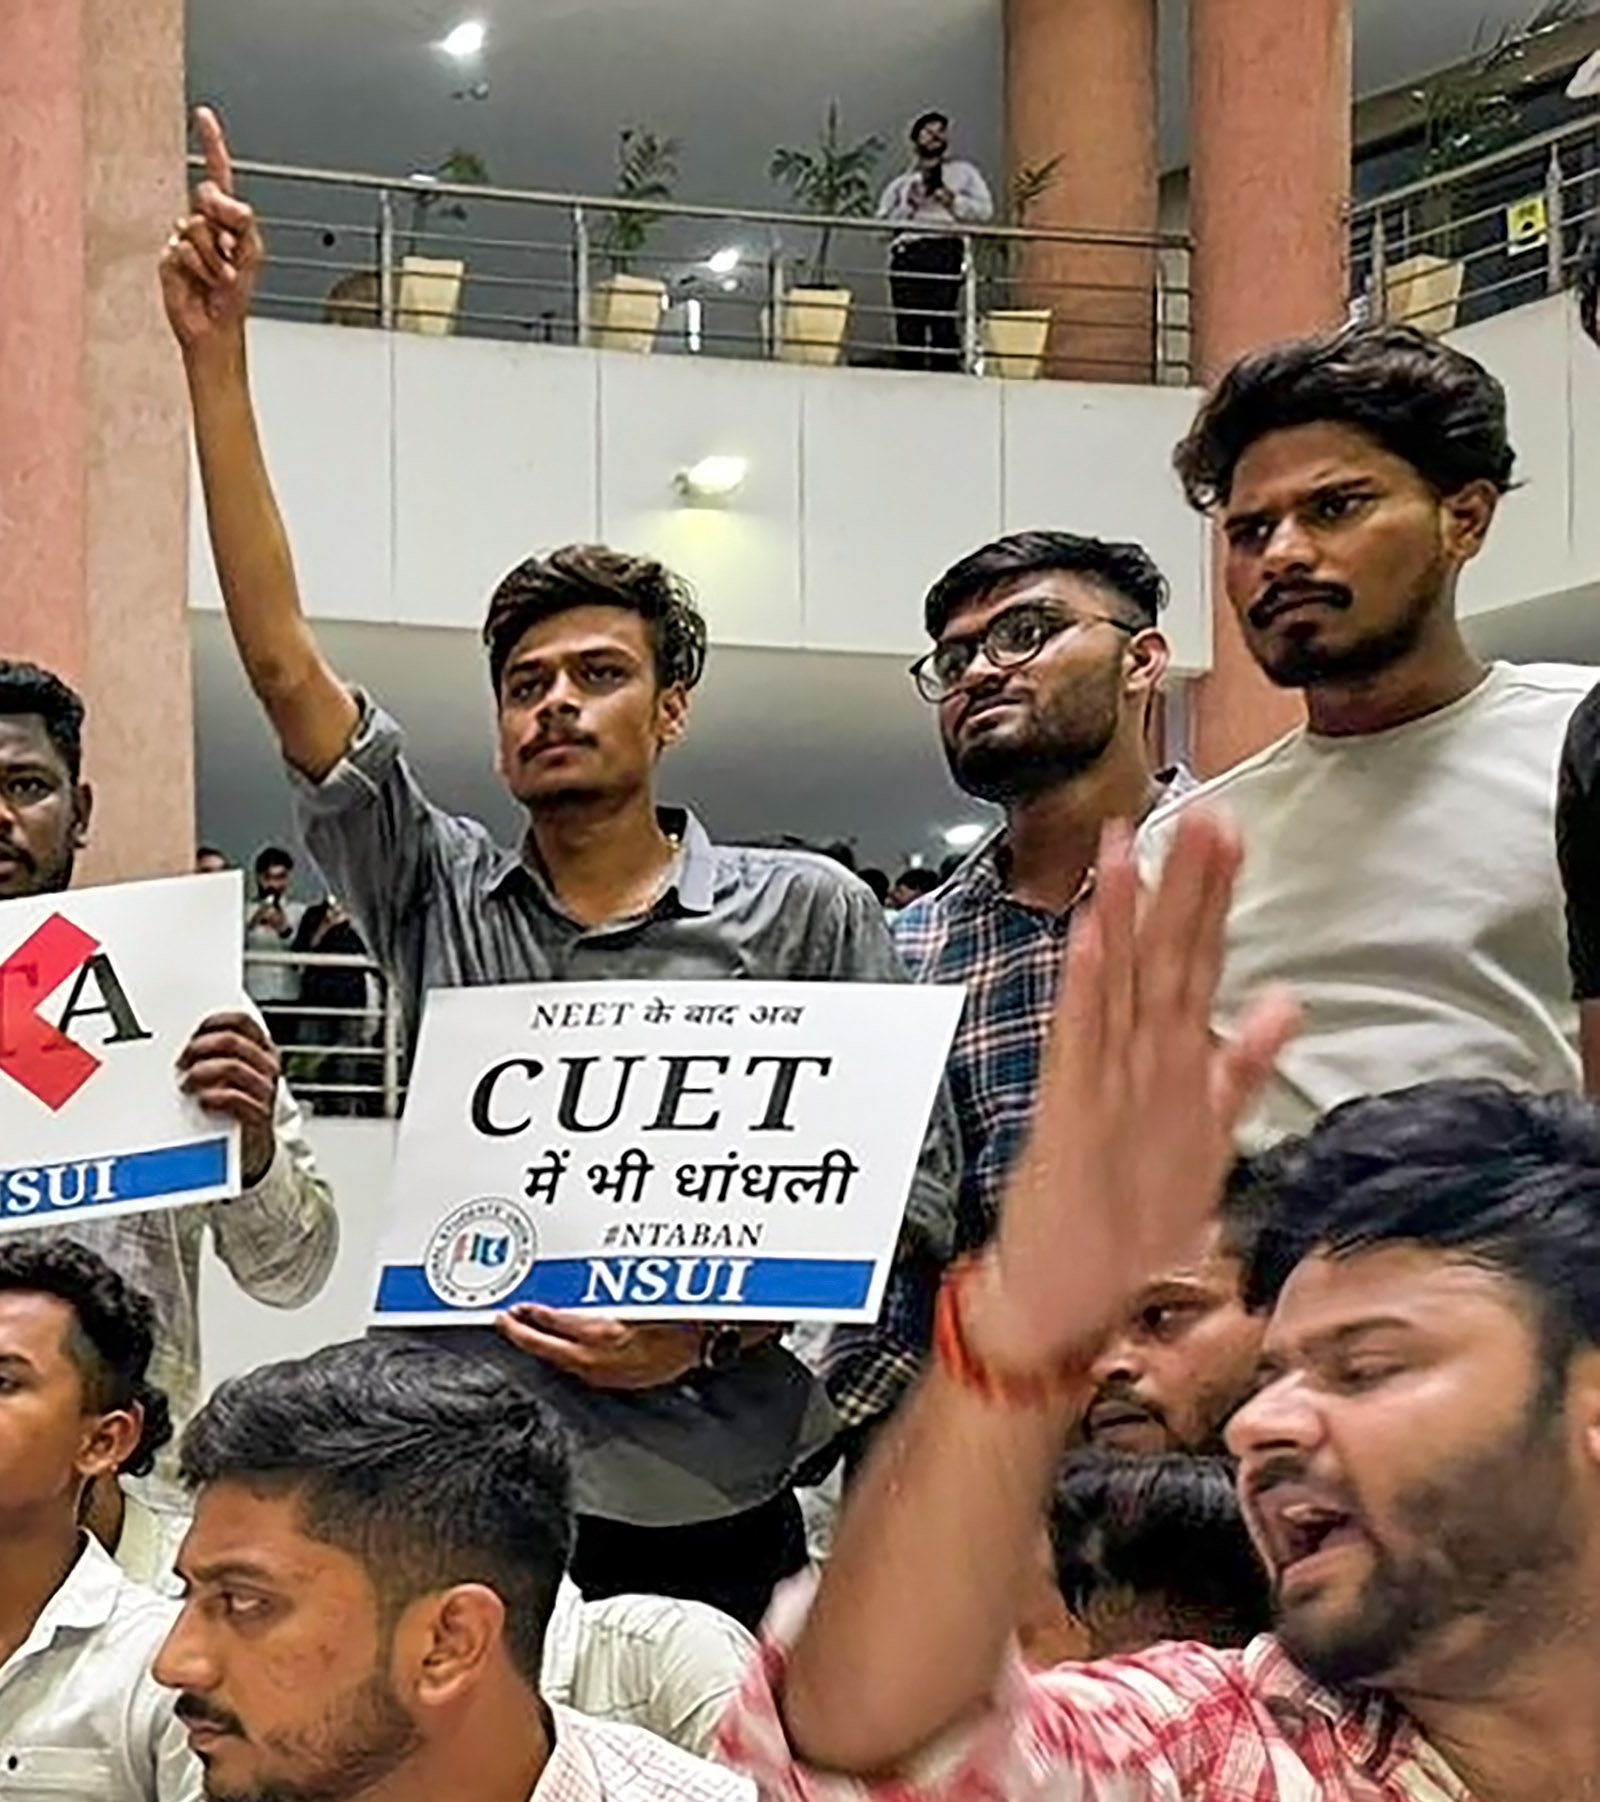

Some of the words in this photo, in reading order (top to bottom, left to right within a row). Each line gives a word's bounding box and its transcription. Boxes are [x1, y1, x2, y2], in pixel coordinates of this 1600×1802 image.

[530, 1001, 635, 1029] NEET
[643, 996, 675, 1025] के
[472, 1056, 831, 1137] CUET
[525, 1149, 570, 1204] में
[587, 1148, 654, 1202] भी
[676, 1148, 859, 1203] धांधली
[602, 1222, 764, 1249] #NTABAN
[582, 1260, 749, 1303] NSUI
